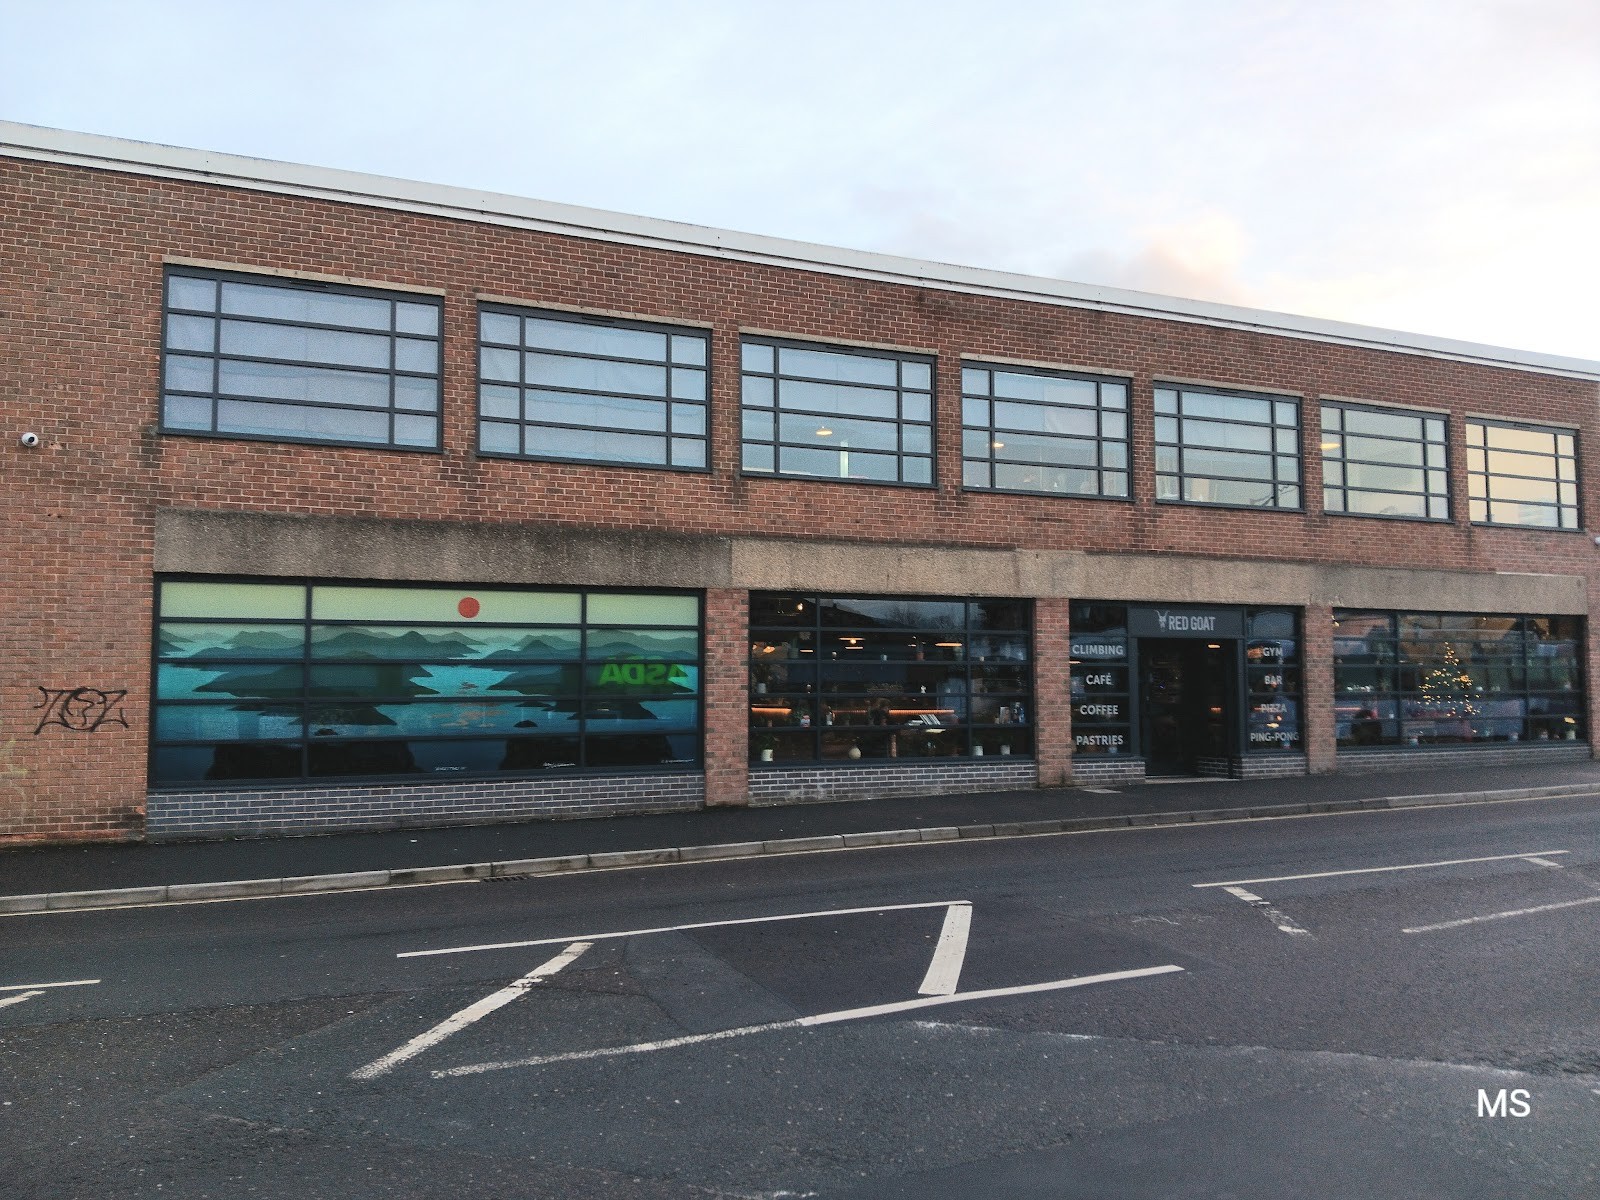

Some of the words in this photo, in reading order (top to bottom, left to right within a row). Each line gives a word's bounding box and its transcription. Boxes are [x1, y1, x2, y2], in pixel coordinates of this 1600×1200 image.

[1168, 615, 1188, 631] RED
[1190, 616, 1216, 631] GOAT
[1072, 644, 1124, 655] CLIMBING
[1263, 647, 1283, 657] GYM
[1086, 672, 1113, 685] CAFÉ
[1264, 675, 1283, 685] BAR
[1080, 704, 1119, 715] COFFEE
[1260, 703, 1287, 713] PIZZA
[1076, 735, 1124, 745] PASTRIES
[1250, 731, 1299, 742] PING-PONG
